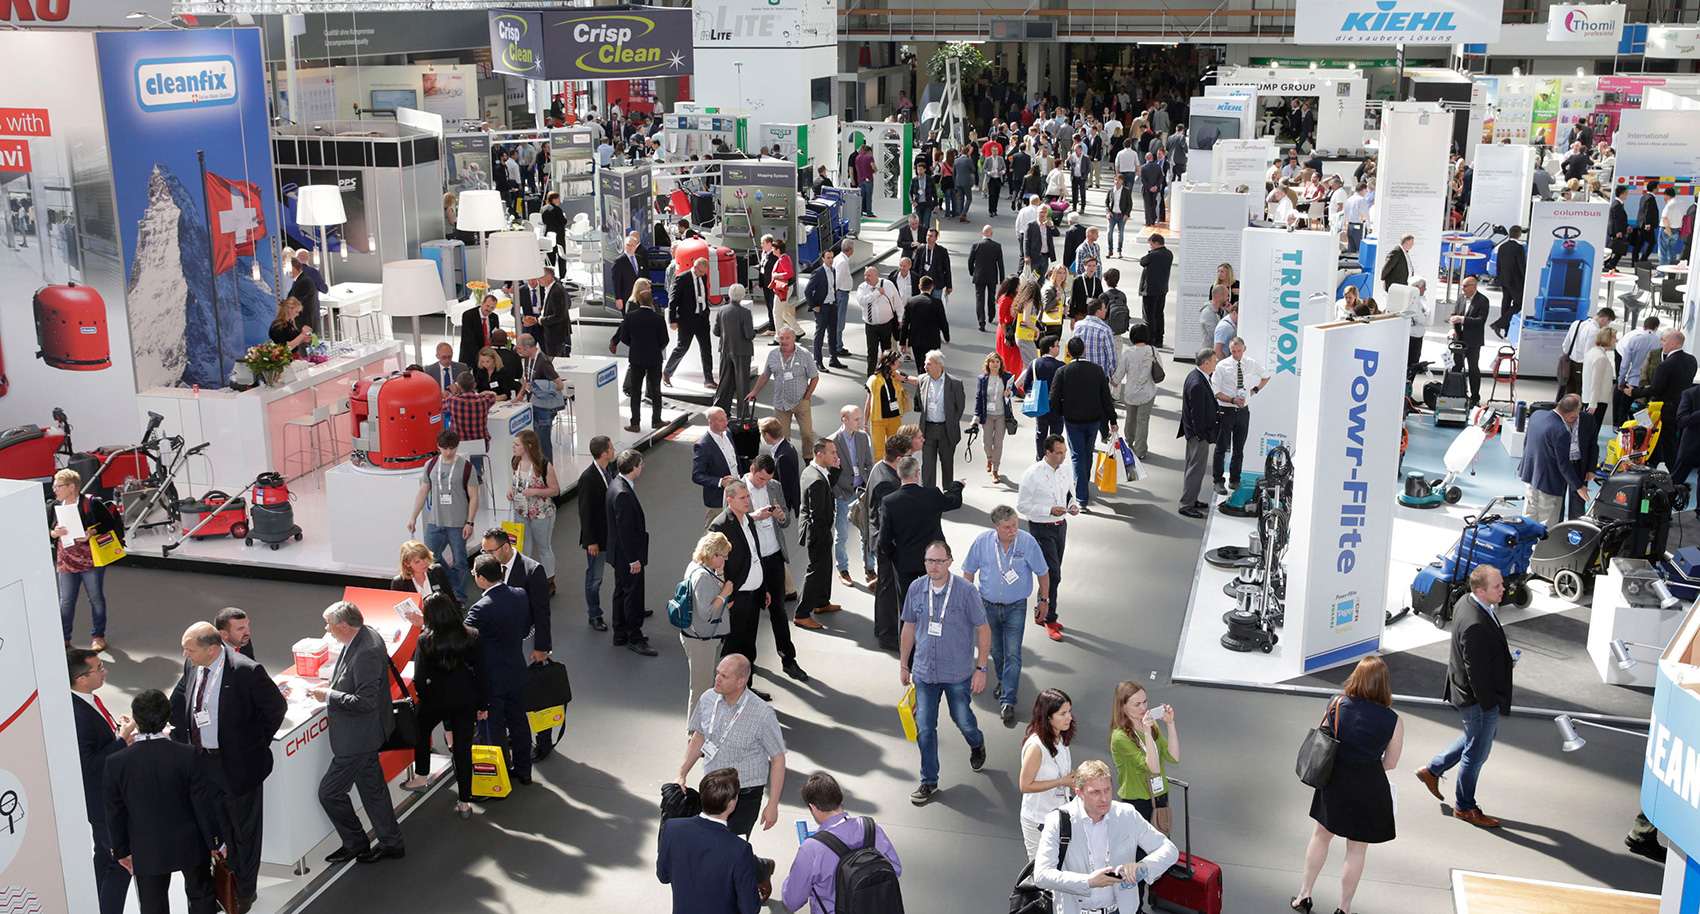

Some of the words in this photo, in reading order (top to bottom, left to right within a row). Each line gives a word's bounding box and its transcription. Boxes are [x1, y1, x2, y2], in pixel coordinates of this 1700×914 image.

[1341, 8, 1456, 31] KIEHL
[1573, 20, 1615, 31] Thomil
[499, 21, 520, 45] Crisp
[574, 24, 631, 46] Crisp
[509, 42, 533, 63] Clean
[599, 44, 661, 64] Clean
[146, 69, 227, 95] cleanfix
[1281, 83, 1316, 91] GROUP
[6, 112, 44, 132] with
[1276, 249, 1303, 375] TRUVOX
[1337, 348, 1379, 574] Powr-Flite
[286, 716, 329, 757] CHICO
